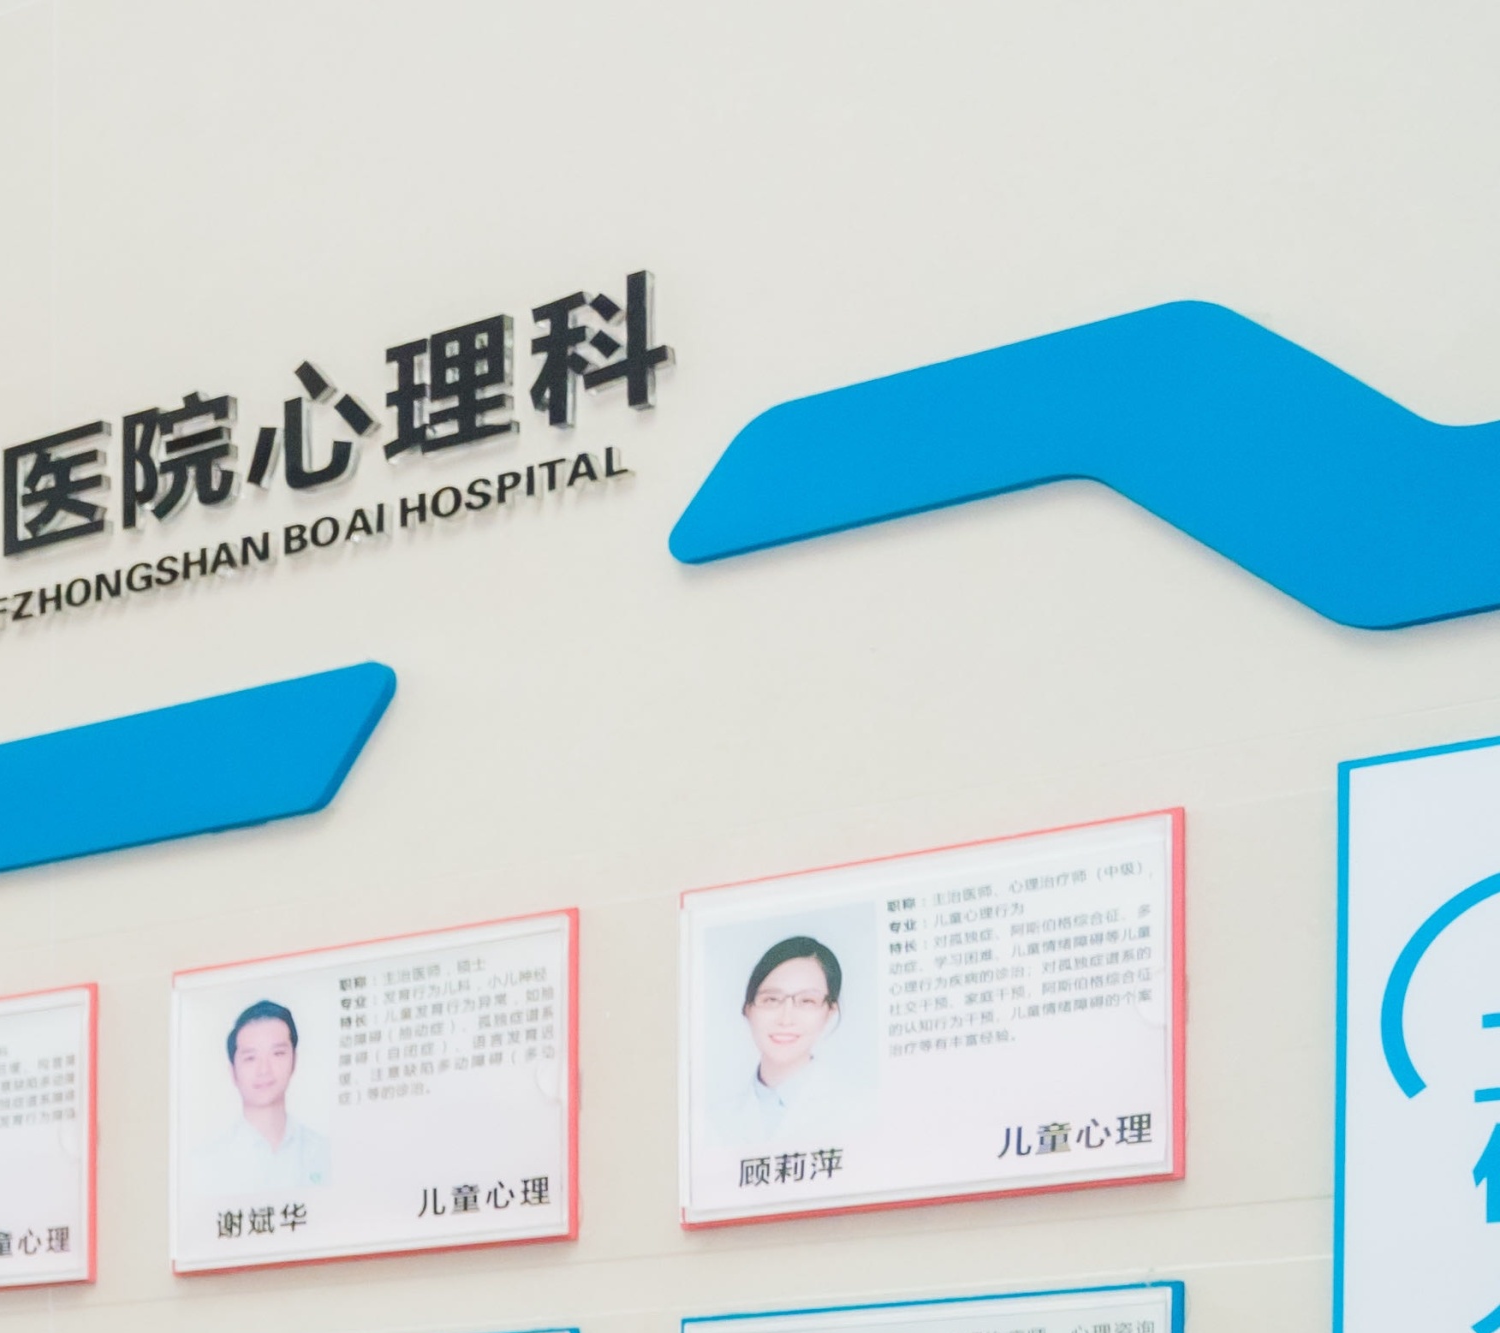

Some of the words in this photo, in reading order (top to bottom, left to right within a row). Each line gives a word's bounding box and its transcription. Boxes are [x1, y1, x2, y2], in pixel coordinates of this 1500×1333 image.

[282, 508, 385, 562] BOAI
[399, 445, 630, 530] HOSPITAL
[889, 902, 1024, 934] 专业：儿童心理行为
[998, 1111, 1154, 1162] 儿童心理
[737, 1146, 846, 1189] 顾莉萍
[418, 1174, 552, 1219] 儿童心理
[215, 1200, 309, 1241] 谢斌华
